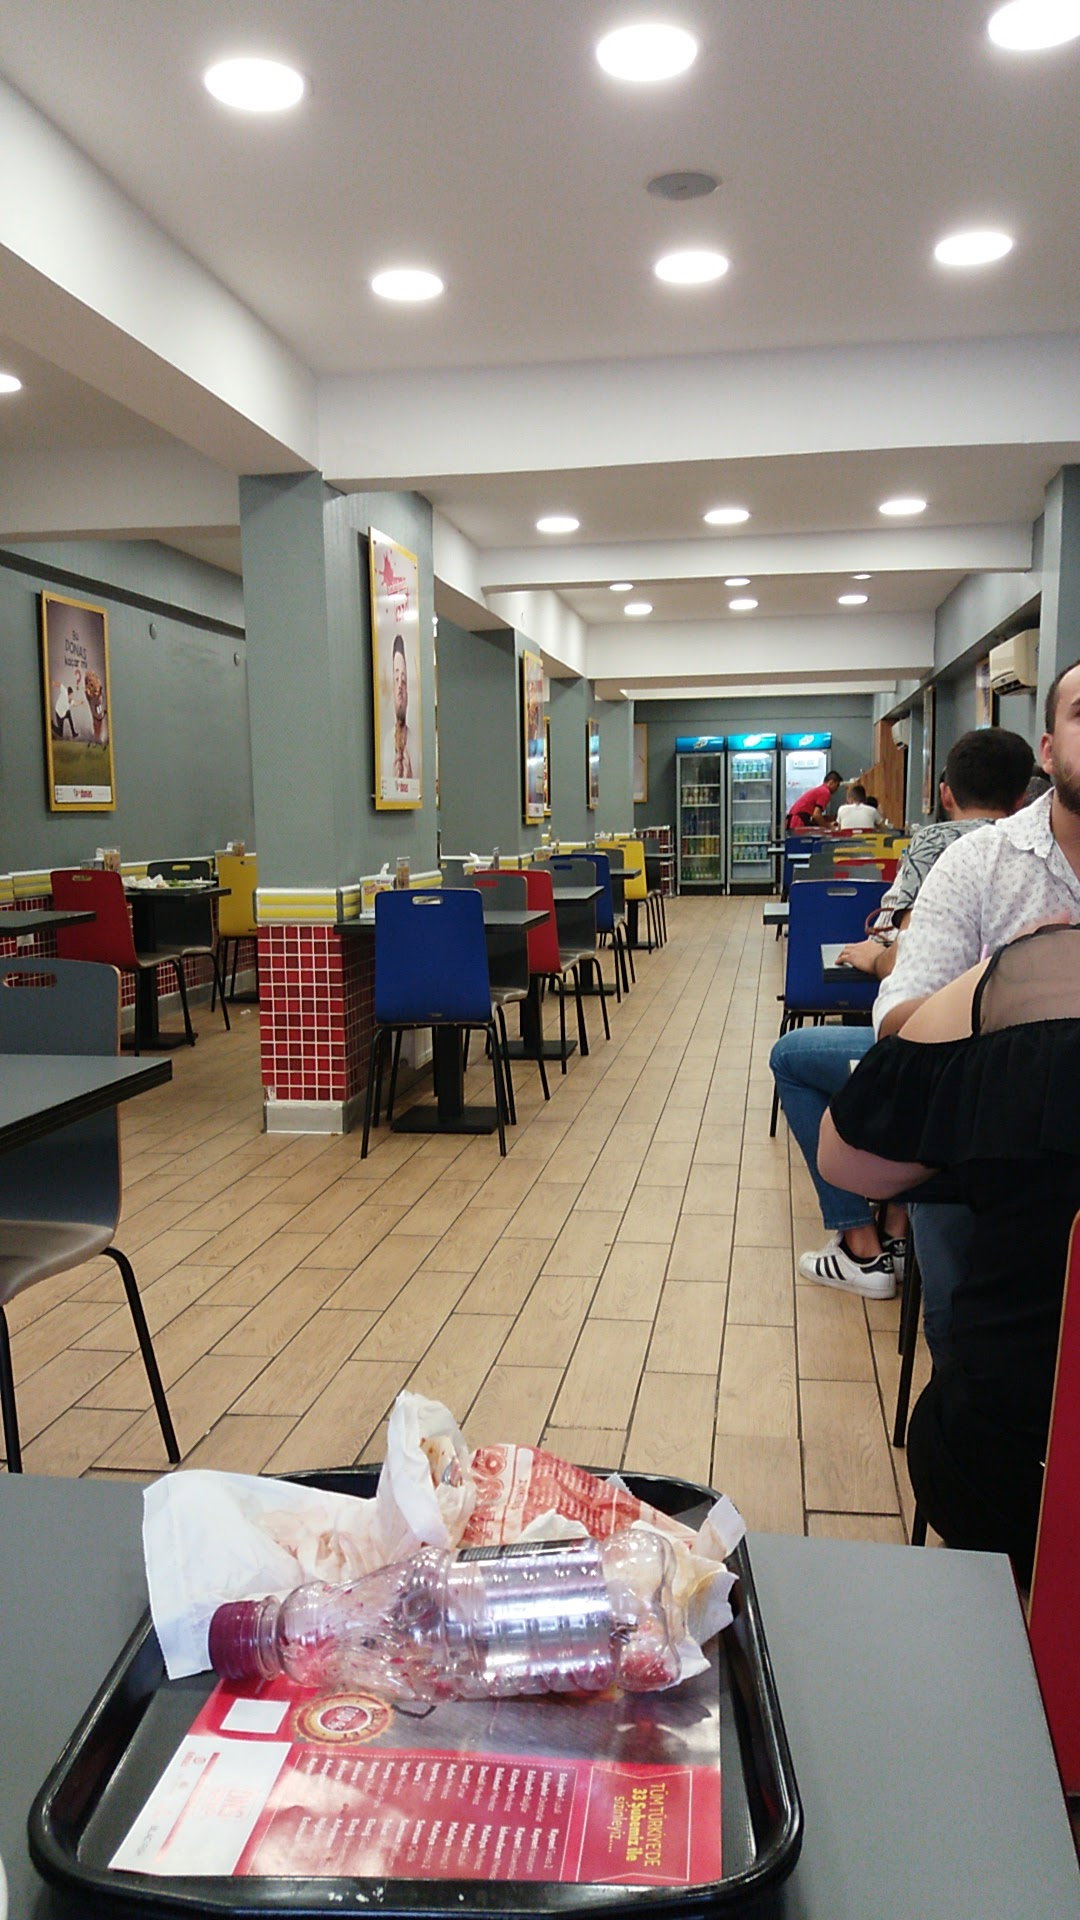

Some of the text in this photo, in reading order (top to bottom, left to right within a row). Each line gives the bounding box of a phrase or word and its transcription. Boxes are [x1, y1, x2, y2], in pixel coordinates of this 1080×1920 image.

[649, 1783, 669, 1805] TÜM
[626, 1788, 648, 1862] 33 Şubemiz ile
